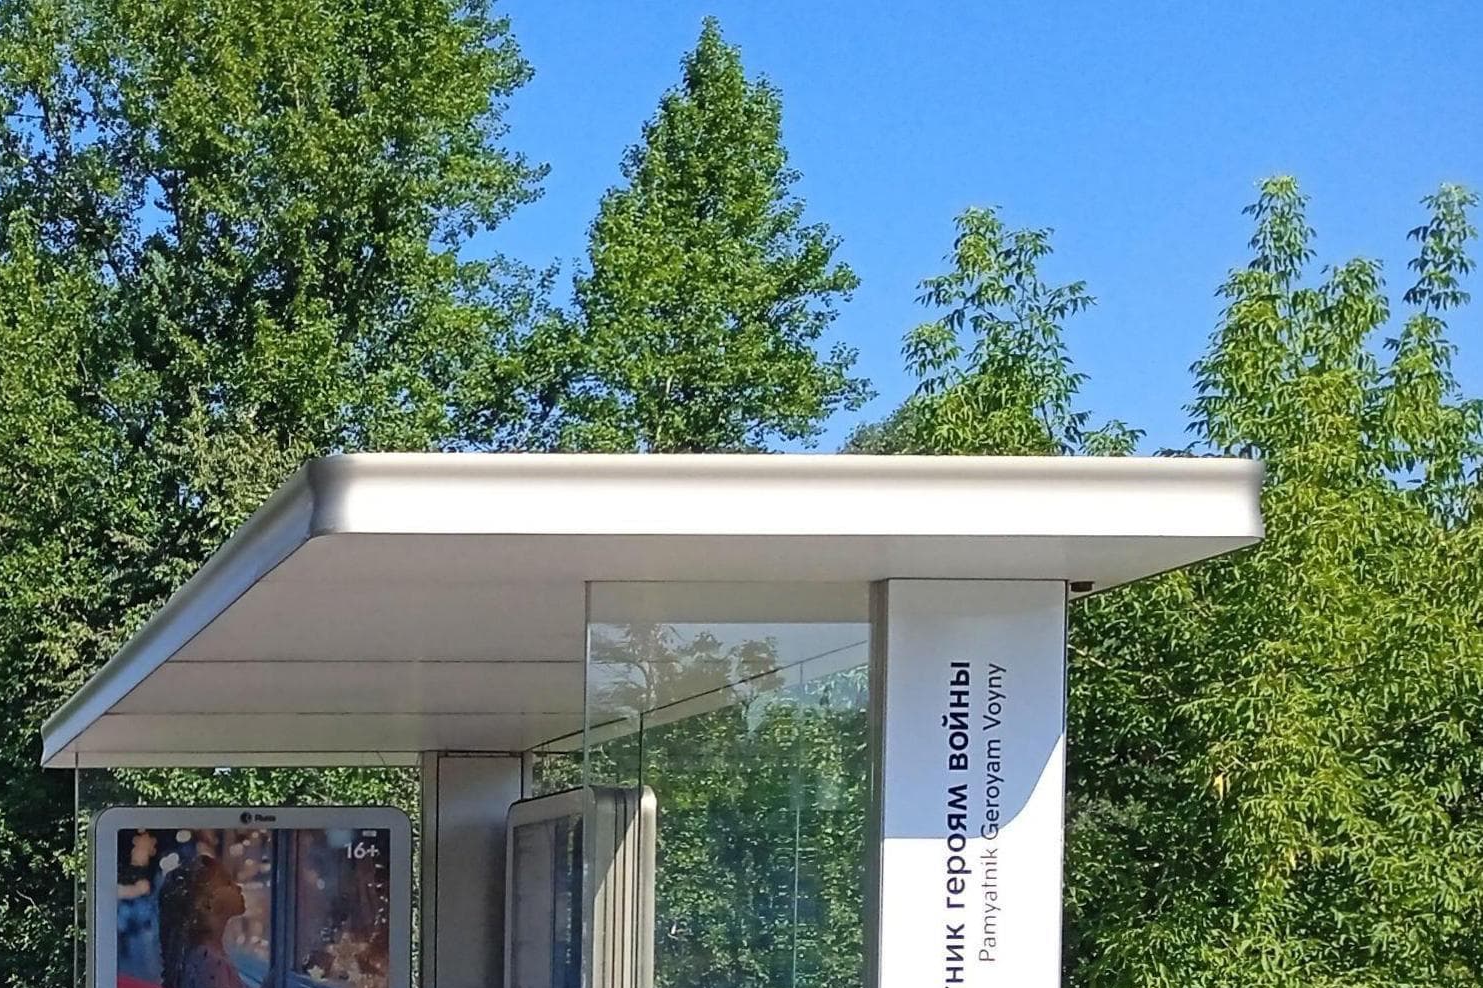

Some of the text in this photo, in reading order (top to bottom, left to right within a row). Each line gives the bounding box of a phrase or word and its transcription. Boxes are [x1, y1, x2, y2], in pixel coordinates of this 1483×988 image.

[942, 661, 971, 771] войны
[344, 841, 379, 860] 16+
[946, 783, 972, 909] героям
[979, 663, 1007, 962] Pamyatnik Geroyam Voyny
